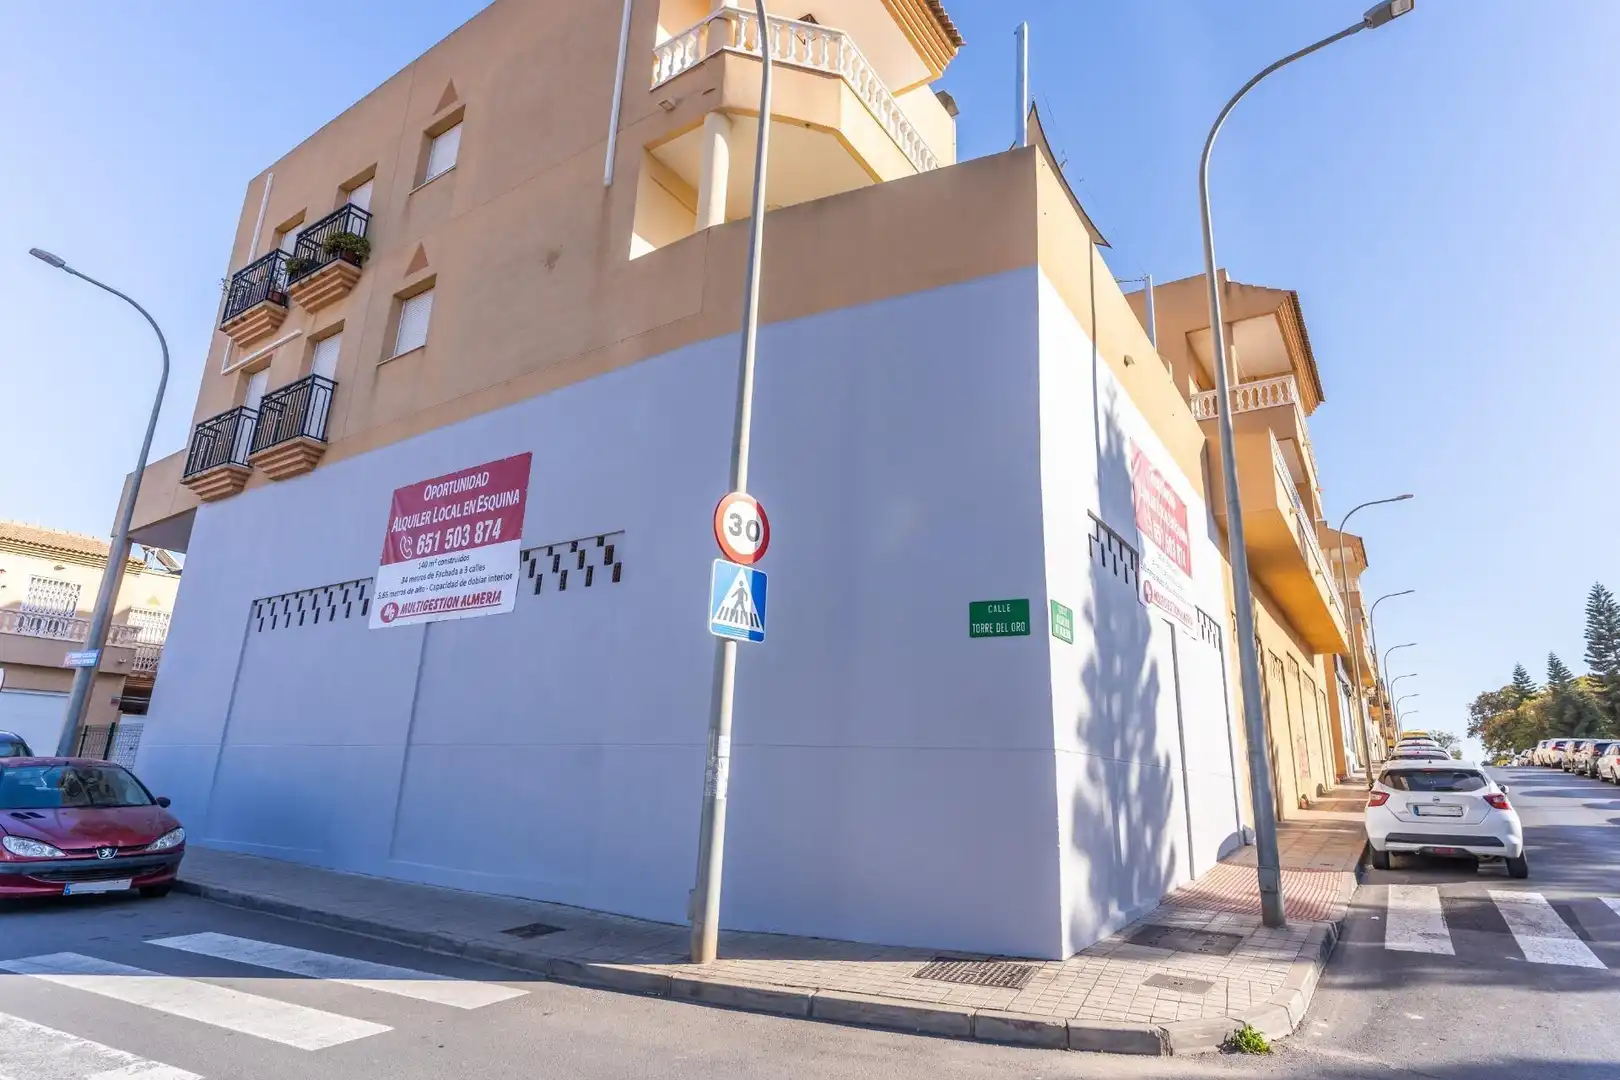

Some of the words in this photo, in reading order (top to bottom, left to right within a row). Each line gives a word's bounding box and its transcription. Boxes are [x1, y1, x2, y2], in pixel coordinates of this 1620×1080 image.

[424, 471, 490, 501] OPORTUNIDAD
[391, 510, 434, 533] ALQUILER
[433, 503, 462, 524] LOCAL
[462, 499, 477, 516] EN
[476, 488, 520, 513] ESQUINA
[416, 530, 441, 555] 651
[444, 524, 470, 549] 503
[474, 518, 502, 544] 874
[728, 512, 760, 542] 30
[437, 554, 470, 566] construidos
[401, 576, 409, 584] 34
[409, 574, 427, 583] metros
[427, 571, 435, 579] de
[435, 566, 459, 578] Fachada
[464, 566, 468, 574] 3
[469, 563, 485, 573] calles
[407, 586, 415, 594] de
[429, 580, 459, 593] Capacidad
[459, 577, 467, 587] de
[488, 572, 513, 583] interior
[400, 596, 460, 615] MULTIGESTION
[460, 590, 502, 607] ALMERIA
[988, 603, 1011, 613] CALLE
[972, 622, 994, 634] TORRE
[996, 622, 1009, 633] DEL
[1011, 621, 1026, 632] ORO
